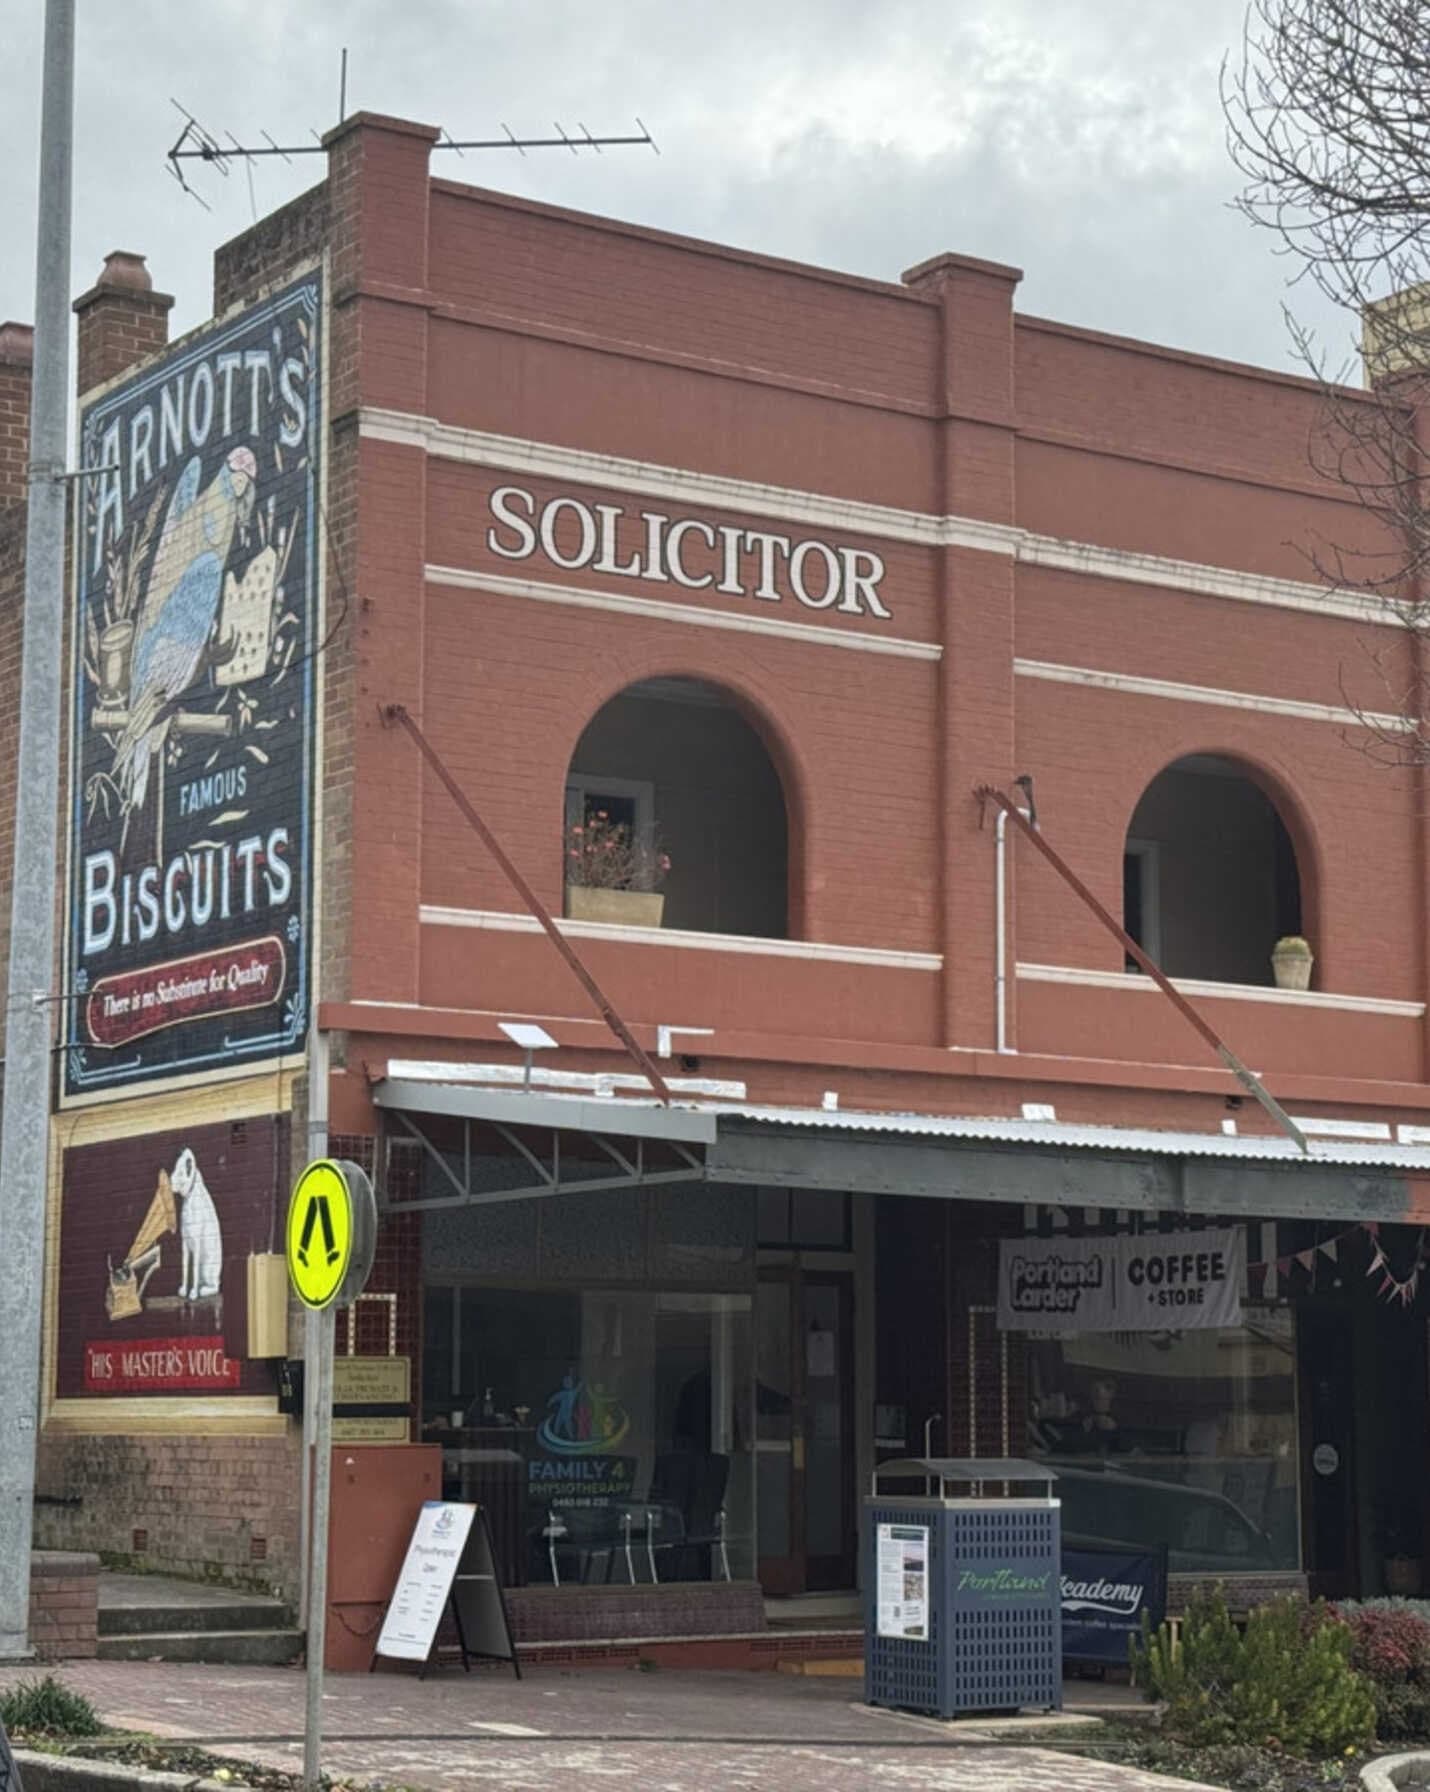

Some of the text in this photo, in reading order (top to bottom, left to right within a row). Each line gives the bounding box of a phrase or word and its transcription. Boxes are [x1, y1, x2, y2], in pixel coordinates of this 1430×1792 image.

[93, 326, 306, 577] ARNOTT'S
[486, 486, 891, 619] SOLICITOR
[180, 766, 247, 815] FAMOUS
[83, 828, 291, 954] BISCUITS
[104, 994, 129, 1017] There
[131, 990, 140, 1011] is
[142, 991, 155, 1008] no
[209, 969, 226, 992] for
[227, 960, 269, 991] Quality
[1010, 1252, 1225, 1287] Portland COFFEE
[122, 1346, 183, 1377] MASTER'S
[187, 1349, 231, 1376] VOICE
[528, 1460, 625, 1480] FAMILY 4
[957, 1568, 1051, 1591] Portland
